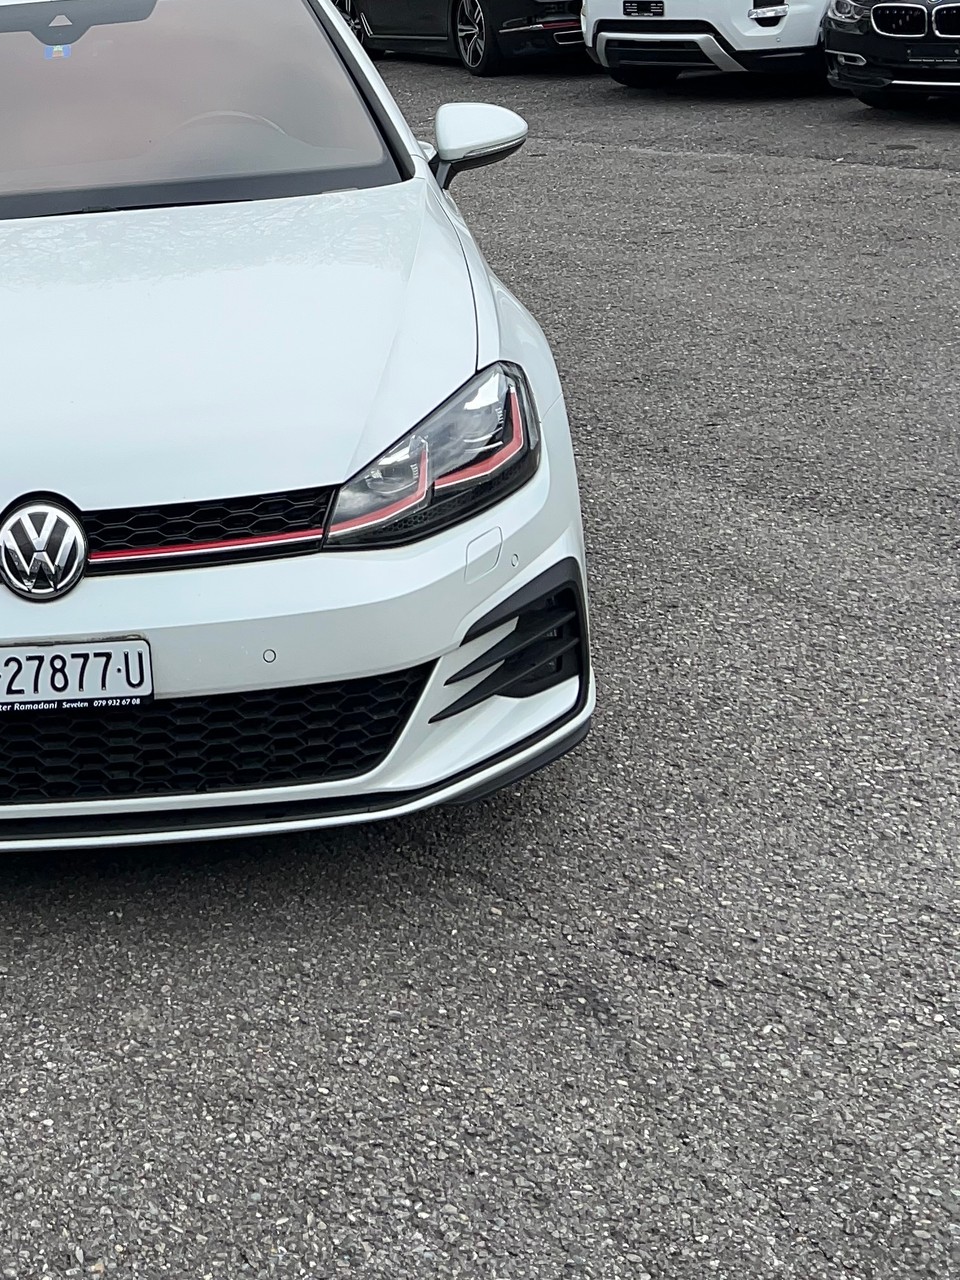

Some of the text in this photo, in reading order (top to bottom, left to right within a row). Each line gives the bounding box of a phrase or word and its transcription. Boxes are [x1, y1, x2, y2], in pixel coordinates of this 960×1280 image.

[14, 701, 58, 711] Ramadani
[93, 699, 107, 707] 079
[107, 698, 120, 706] 932
[121, 698, 131, 706] 67
[131, 697, 141, 705] 08
